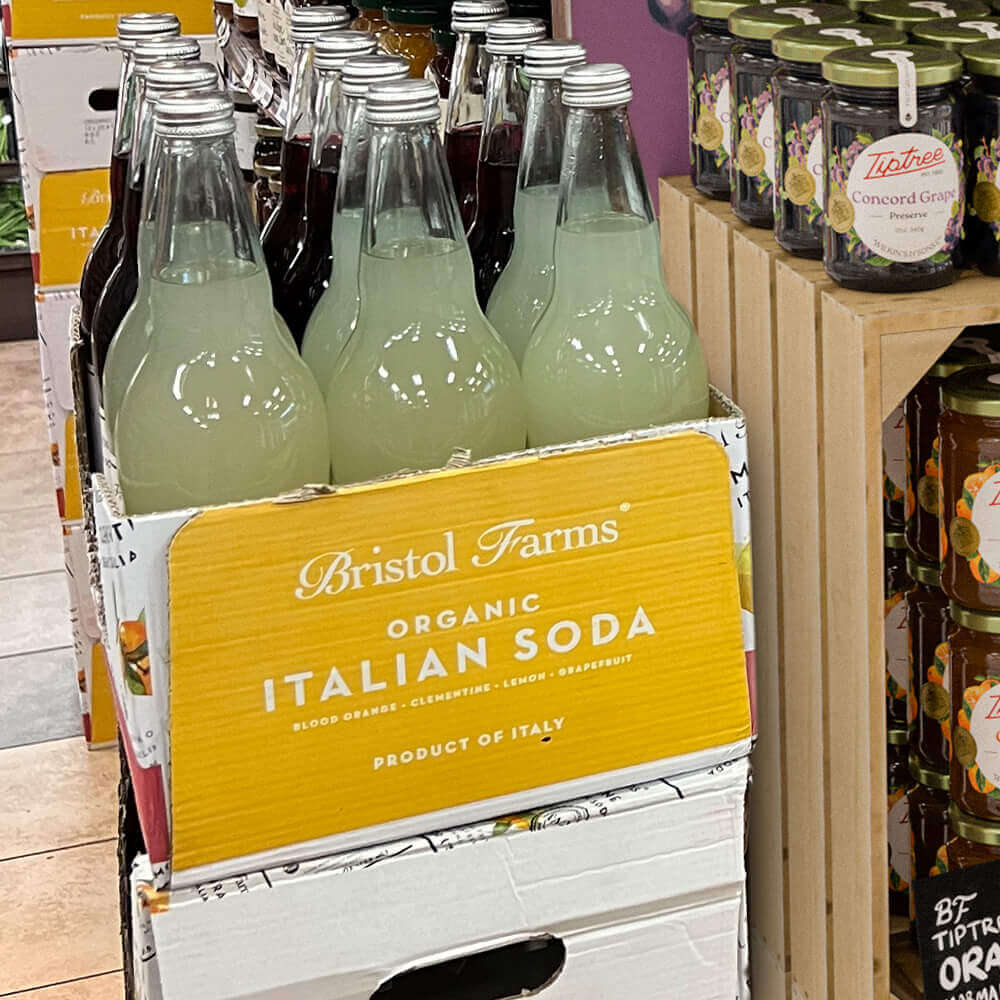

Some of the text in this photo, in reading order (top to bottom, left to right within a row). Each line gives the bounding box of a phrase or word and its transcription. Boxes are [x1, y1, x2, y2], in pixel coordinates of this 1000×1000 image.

[864, 142, 946, 180] Tiptree
[852, 190, 917, 206] Concord
[889, 210, 928, 221] Preserve
[295, 518, 620, 600] Bristol Farms
[387, 593, 540, 638] ORGANIC
[263, 605, 656, 713] ITALIAN SODA
[292, 653, 633, 732] BLOOD ORANGE CLEMENTINE LEMON GRAPEFRUIT
[373, 716, 566, 770] PRODUCT OF ITALY
[934, 891, 978, 926] BF
